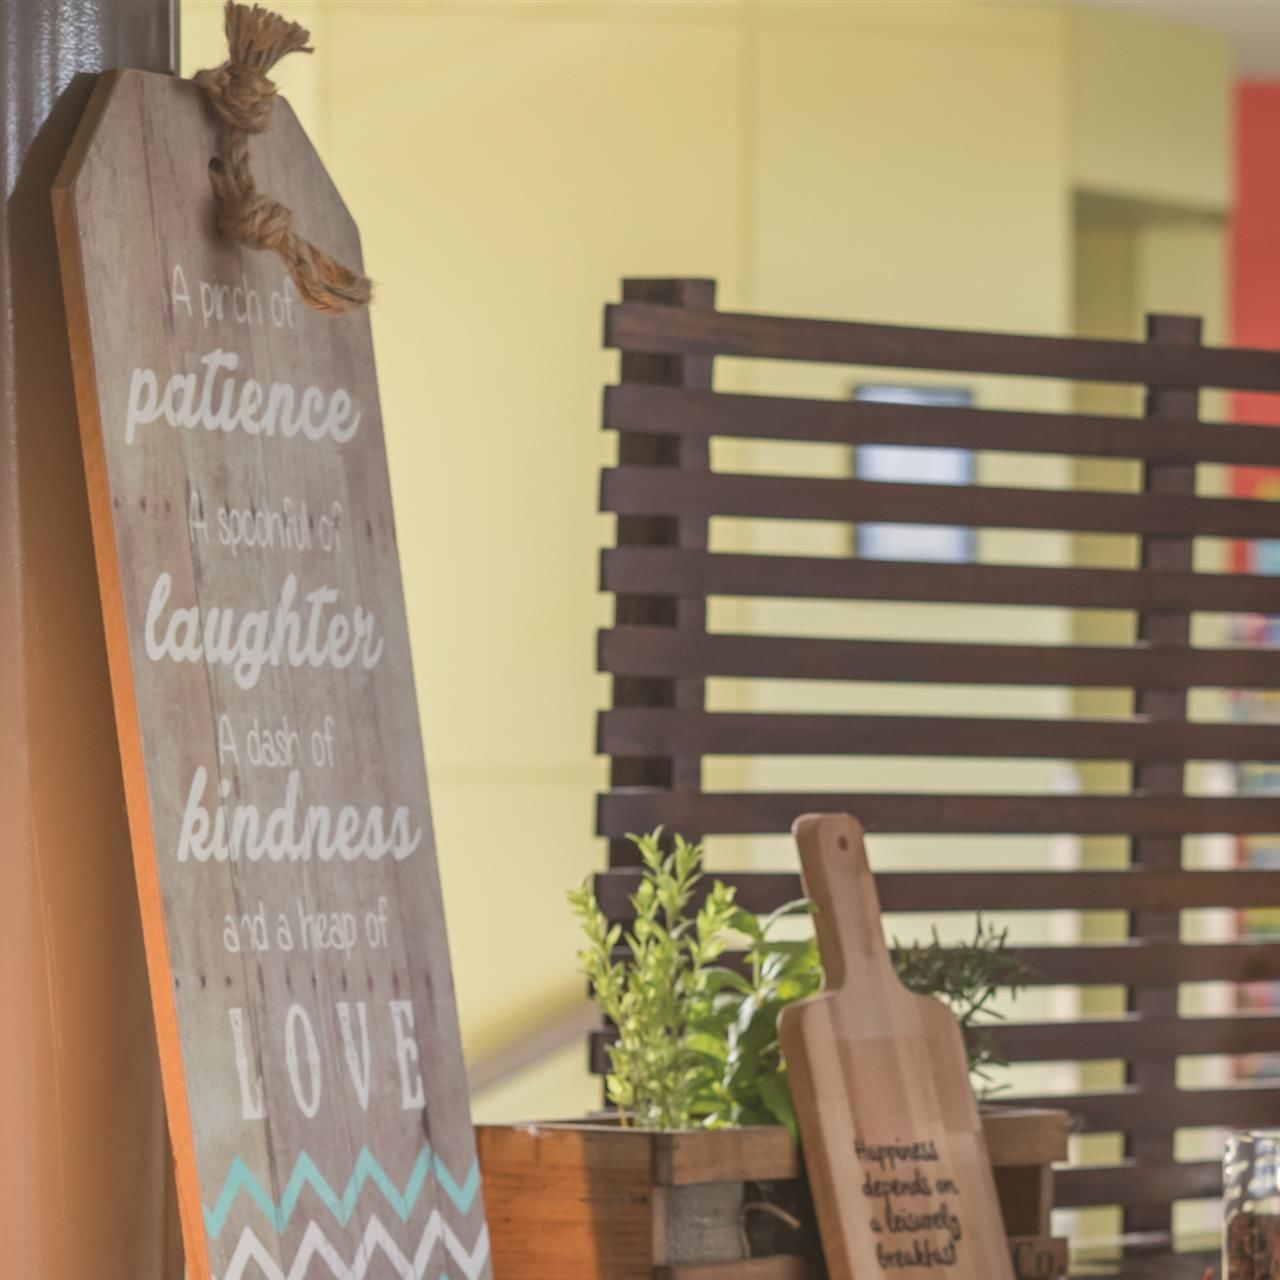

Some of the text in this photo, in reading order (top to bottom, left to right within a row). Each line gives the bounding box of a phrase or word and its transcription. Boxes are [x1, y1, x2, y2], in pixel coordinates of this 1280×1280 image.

[172, 264, 193, 317] A
[270, 276, 296, 328] of
[125, 347, 361, 445] patience
[188, 489, 210, 543] A
[218, 496, 312, 557] spoonful
[144, 572, 384, 690] laughter
[218, 713, 335, 767] A dash of
[176, 765, 421, 863] kindness
[277, 912, 294, 952] a
[298, 899, 357, 960] heap
[365, 896, 389, 949] of
[228, 999, 426, 1121] LOVE
[936, 1179, 960, 1195] on
[875, 1240, 958, 1269] breakfast
